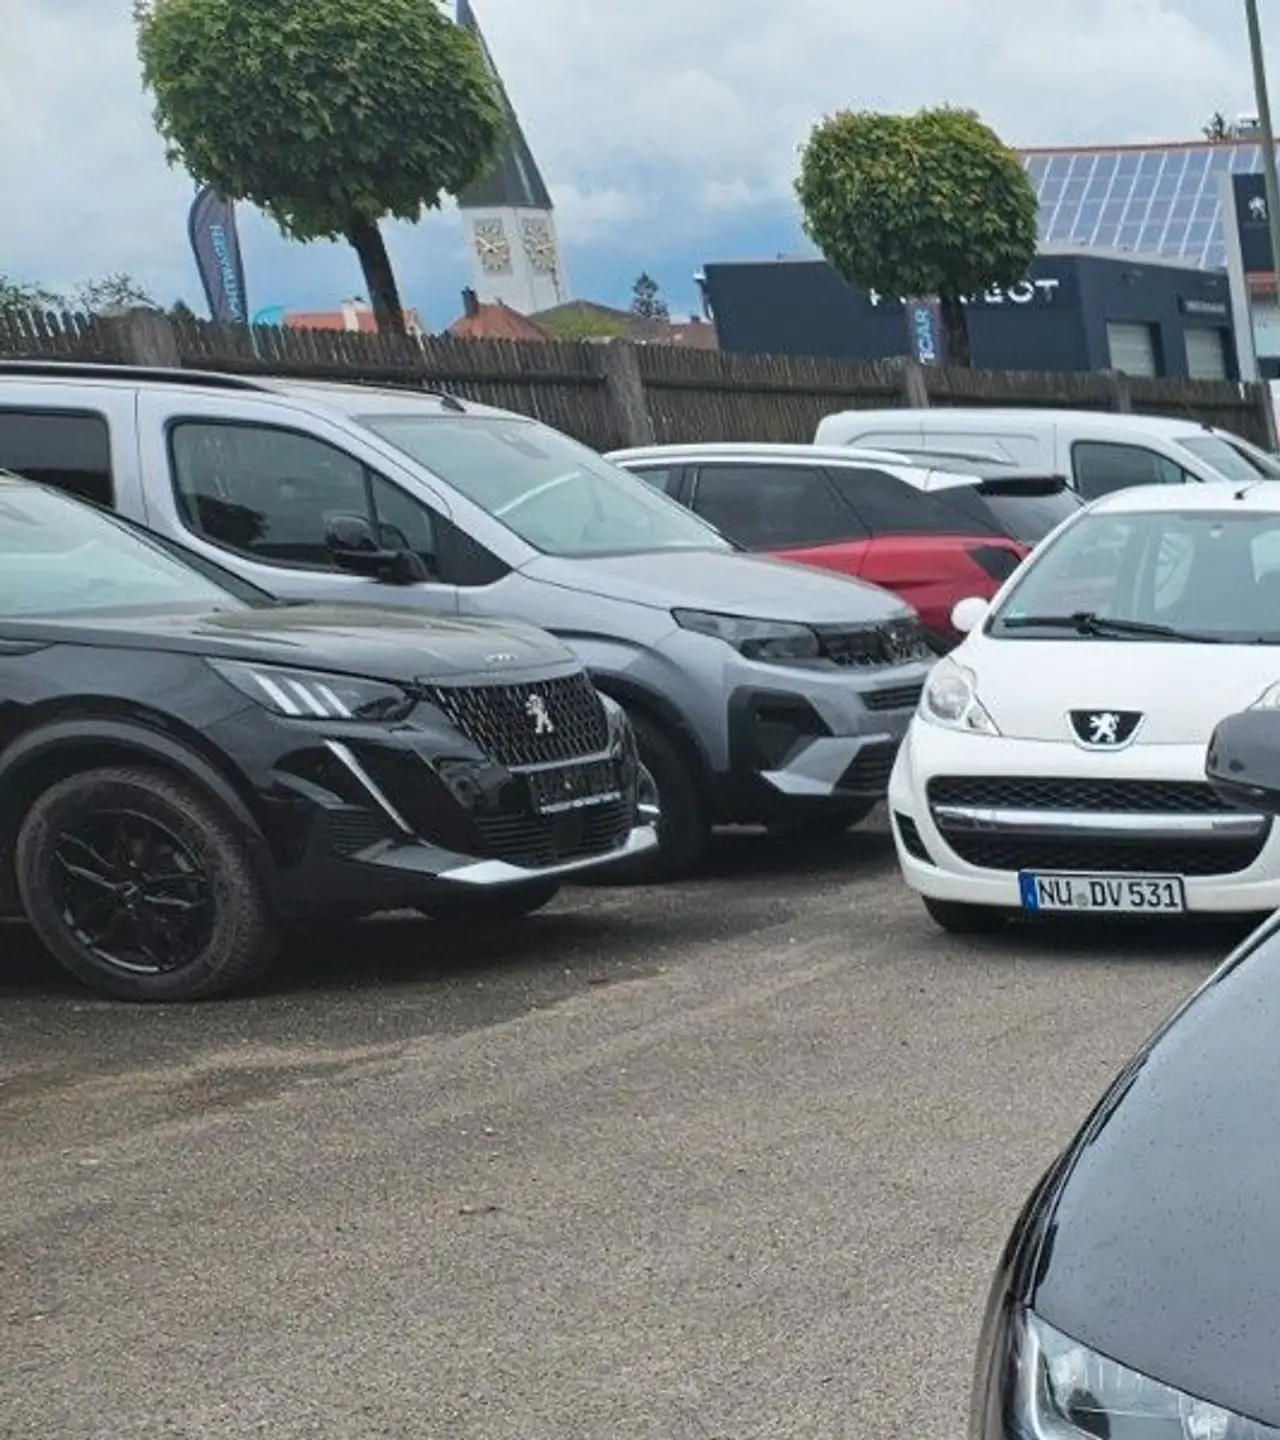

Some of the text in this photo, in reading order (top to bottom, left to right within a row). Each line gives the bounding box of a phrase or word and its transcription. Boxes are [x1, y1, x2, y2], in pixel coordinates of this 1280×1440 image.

[1039, 881, 1179, 908] NU DV 531
